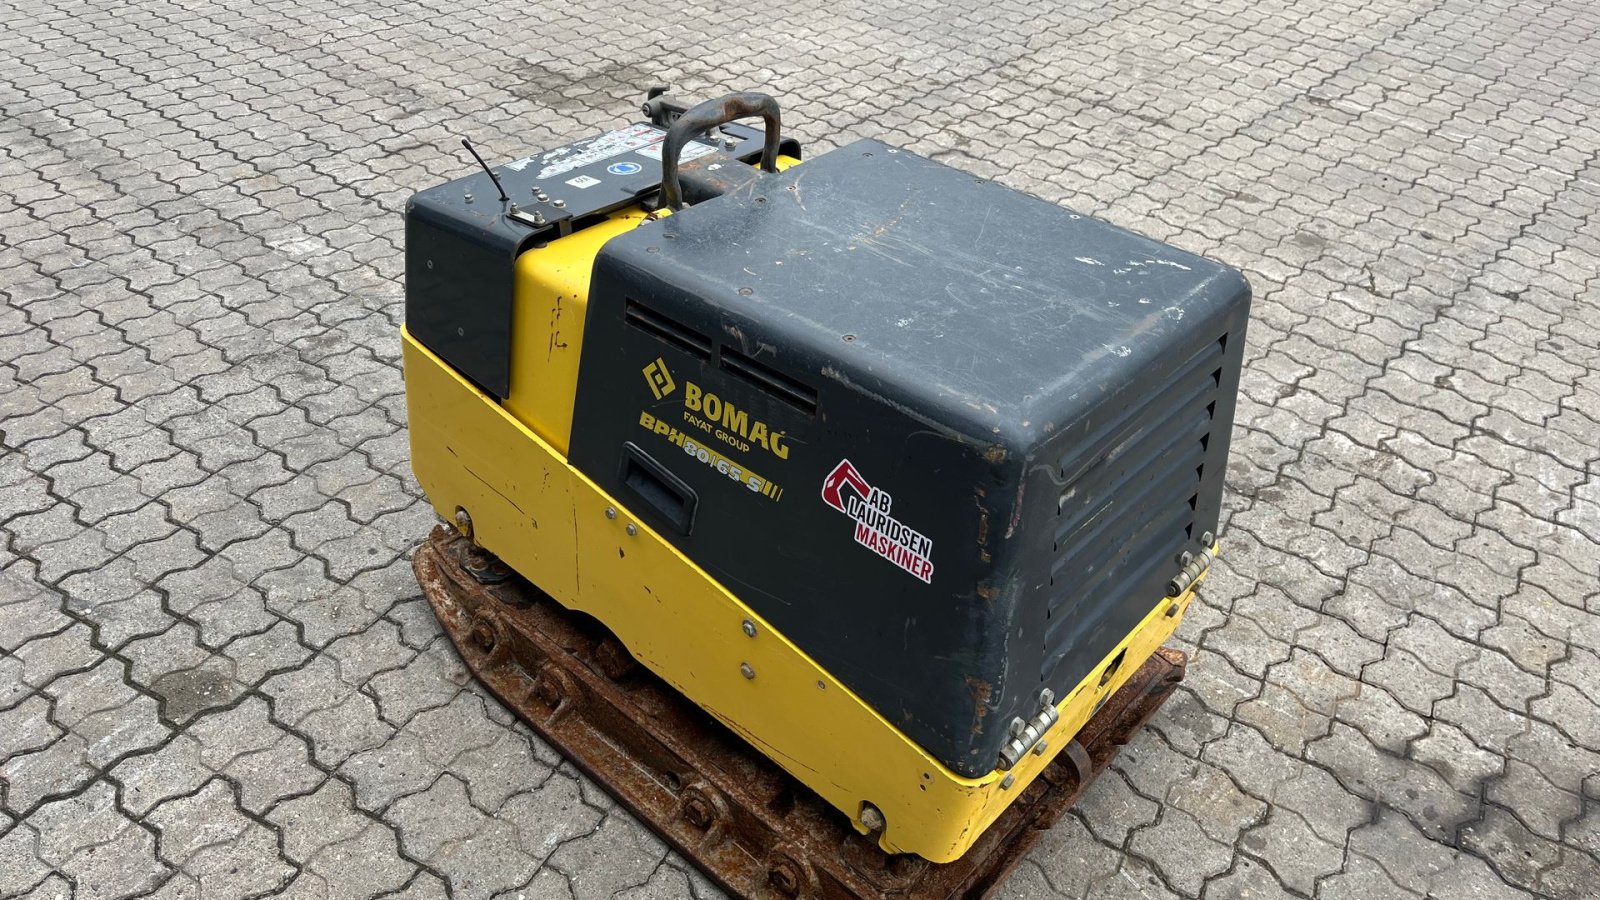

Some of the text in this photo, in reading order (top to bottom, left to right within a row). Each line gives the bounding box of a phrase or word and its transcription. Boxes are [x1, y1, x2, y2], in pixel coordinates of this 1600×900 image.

[683, 411, 750, 453] FAYAT GROUP
[684, 381, 789, 460] BOMAG
[848, 497, 931, 558] LAURIDSEN
[869, 488, 890, 514] AB
[856, 523, 932, 581] MASKINER
